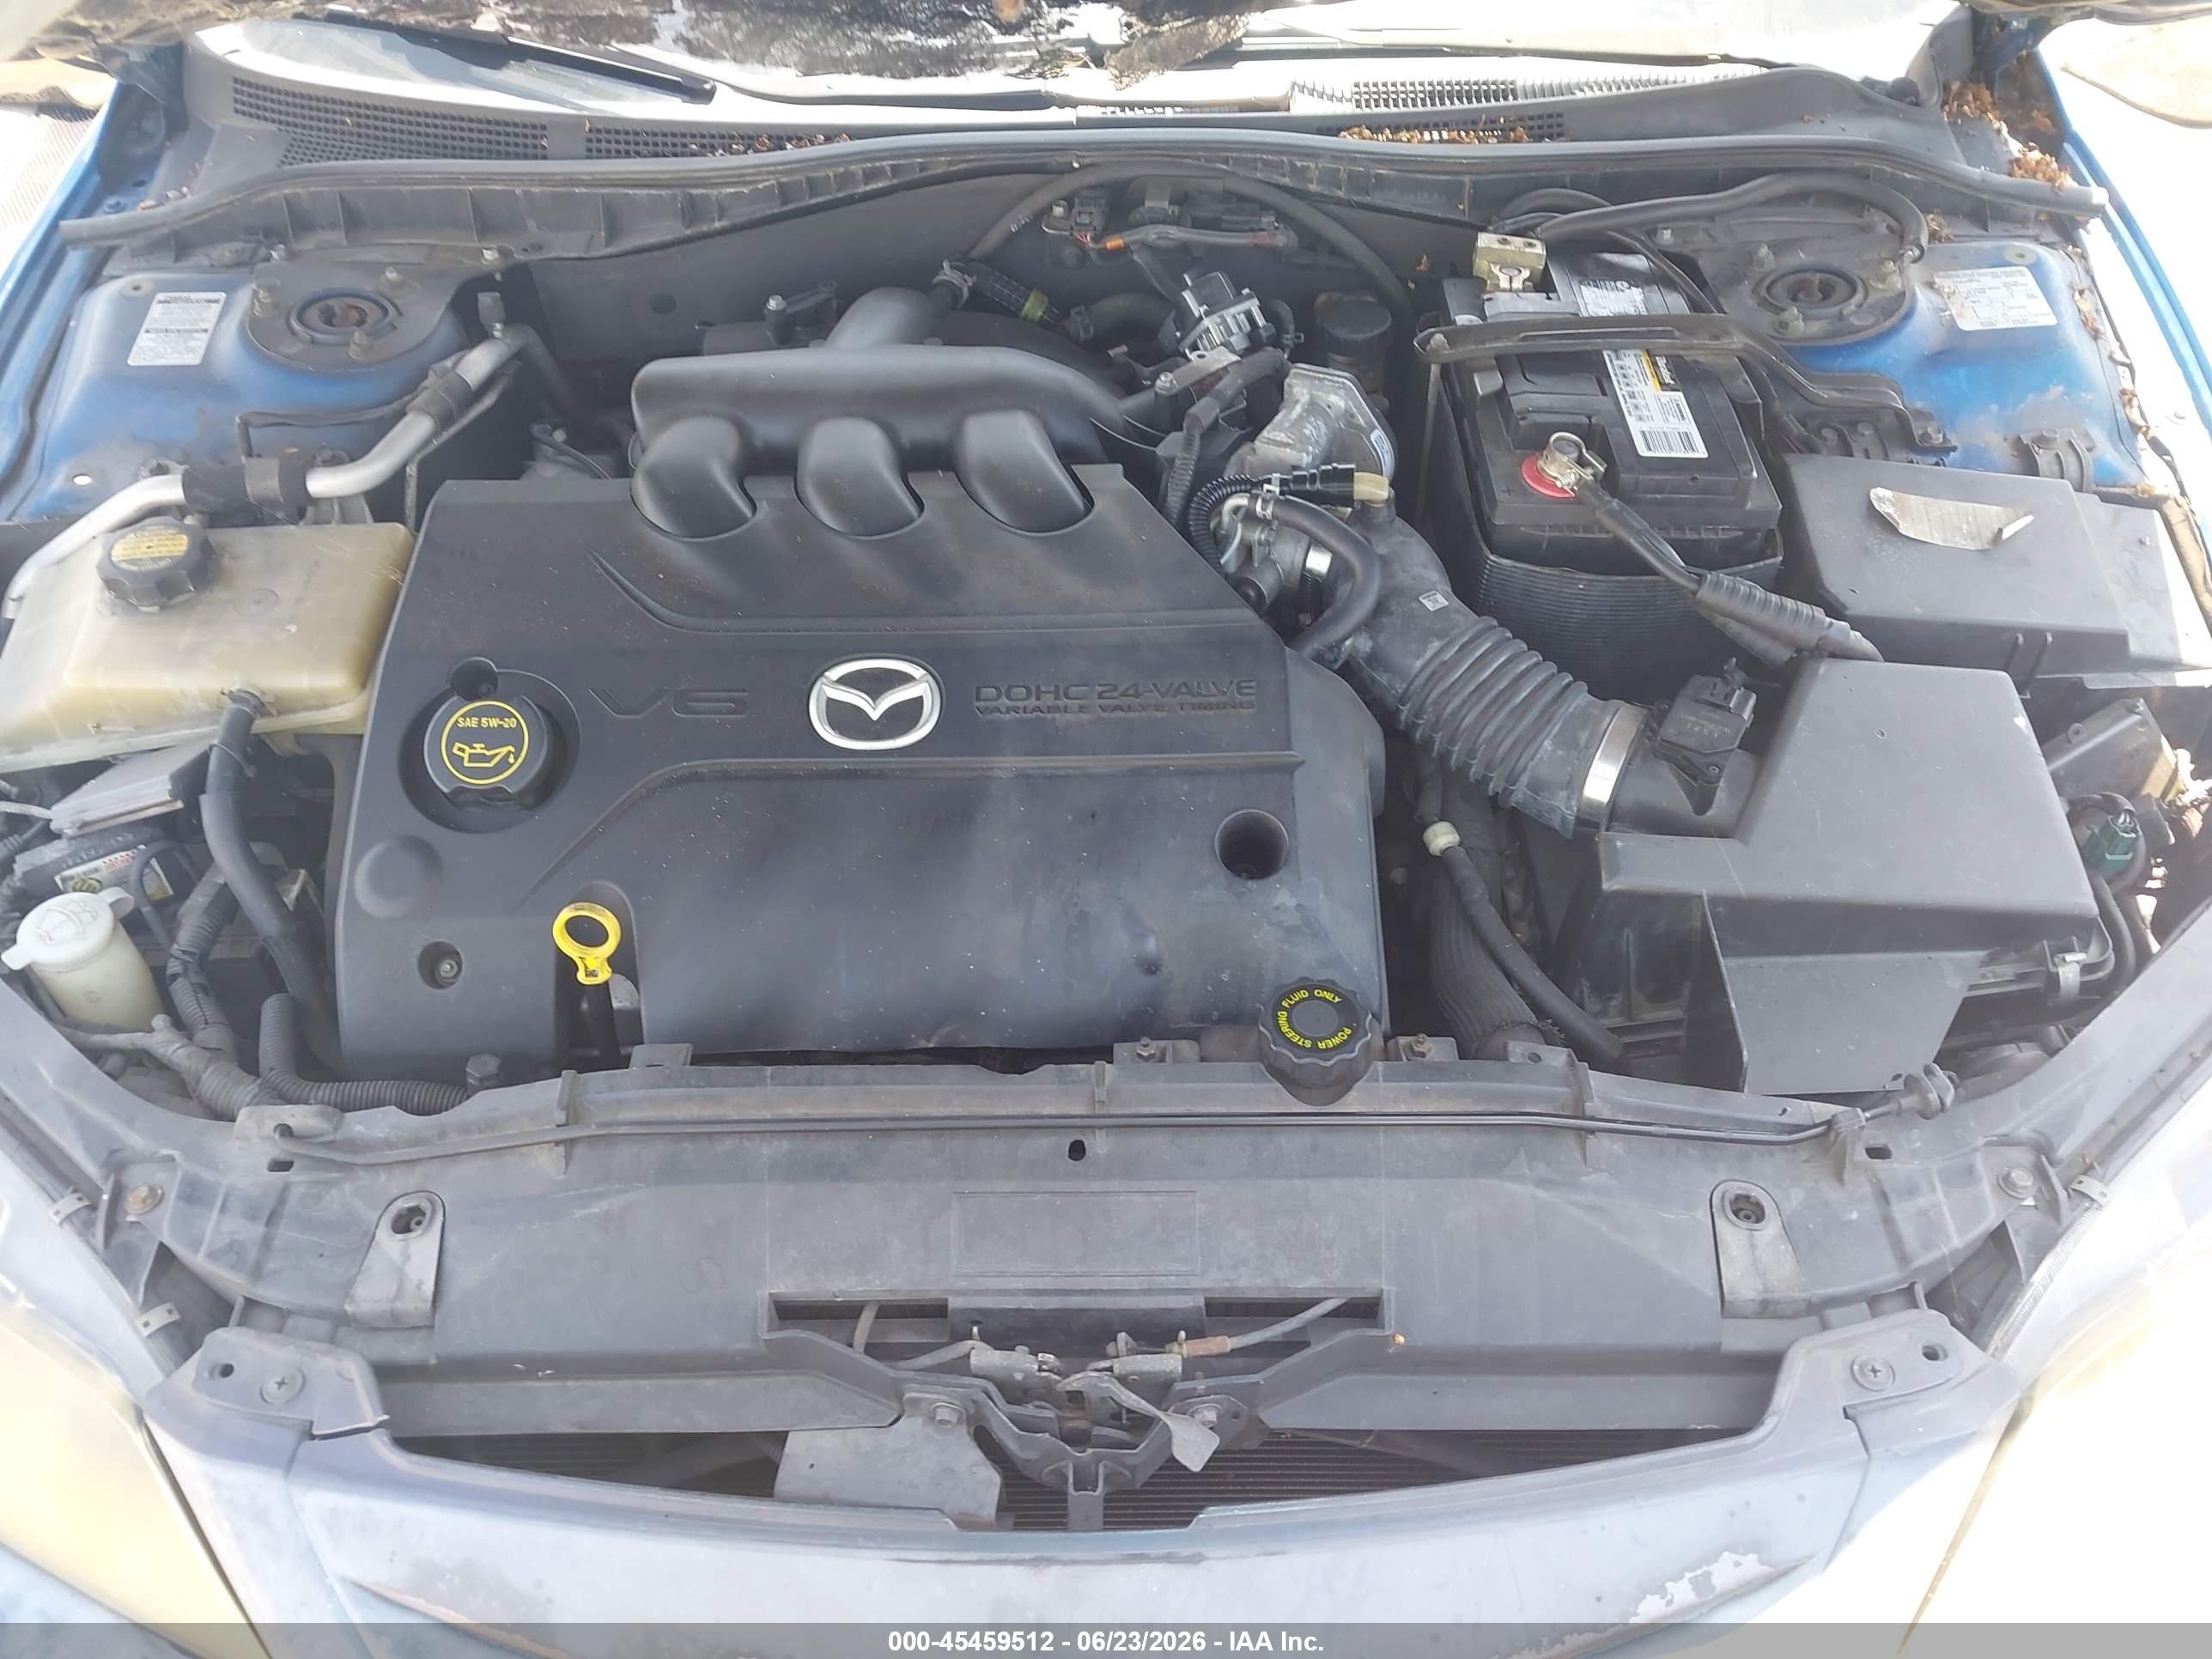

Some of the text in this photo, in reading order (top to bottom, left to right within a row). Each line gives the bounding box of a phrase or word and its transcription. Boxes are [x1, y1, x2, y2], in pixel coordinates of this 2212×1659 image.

[975, 680, 1256, 702] DOHC 24-VALVE
[975, 700, 1255, 715] VARIABLE VALVE TIMING
[456, 716, 517, 728] SAE 5W-20
[1277, 989, 1352, 1048] POWER STEERING FLUID ONLY
